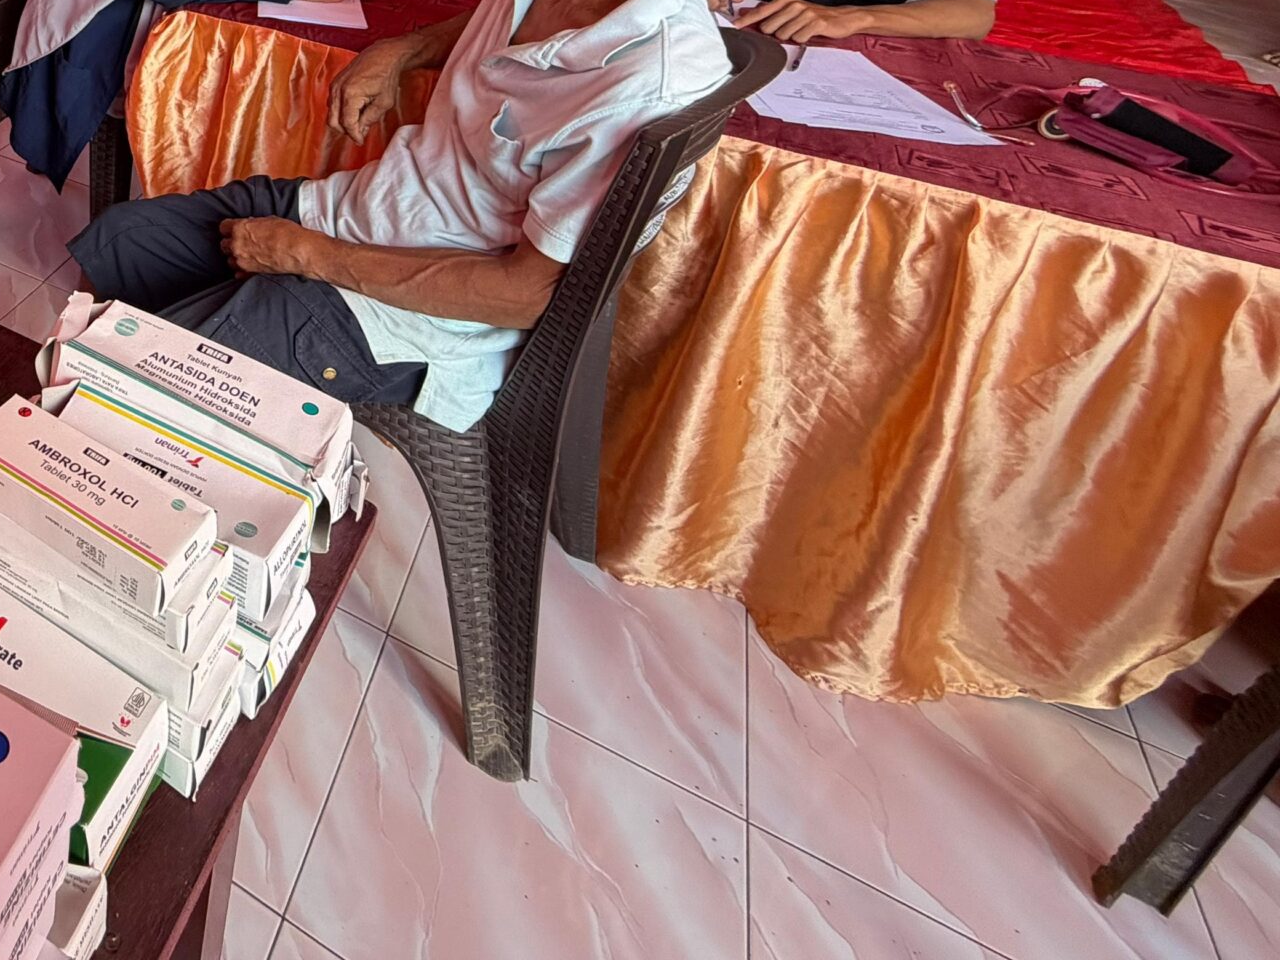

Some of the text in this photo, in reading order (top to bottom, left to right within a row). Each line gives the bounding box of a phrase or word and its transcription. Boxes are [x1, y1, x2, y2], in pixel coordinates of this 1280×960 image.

[187, 353, 243, 383] Tablet Kunyah
[200, 344, 230, 363] TRIFA
[133, 363, 253, 428] Magnesium Hidroksida
[139, 357, 257, 419] Alumunium Hidroksida
[148, 351, 261, 407] ANTASIDA DOEN
[28, 439, 107, 493] AMBROXOL
[155, 437, 190, 459] Triman
[40, 460, 106, 507] Tablet 30 mg
[168, 475, 203, 499] Tablet
